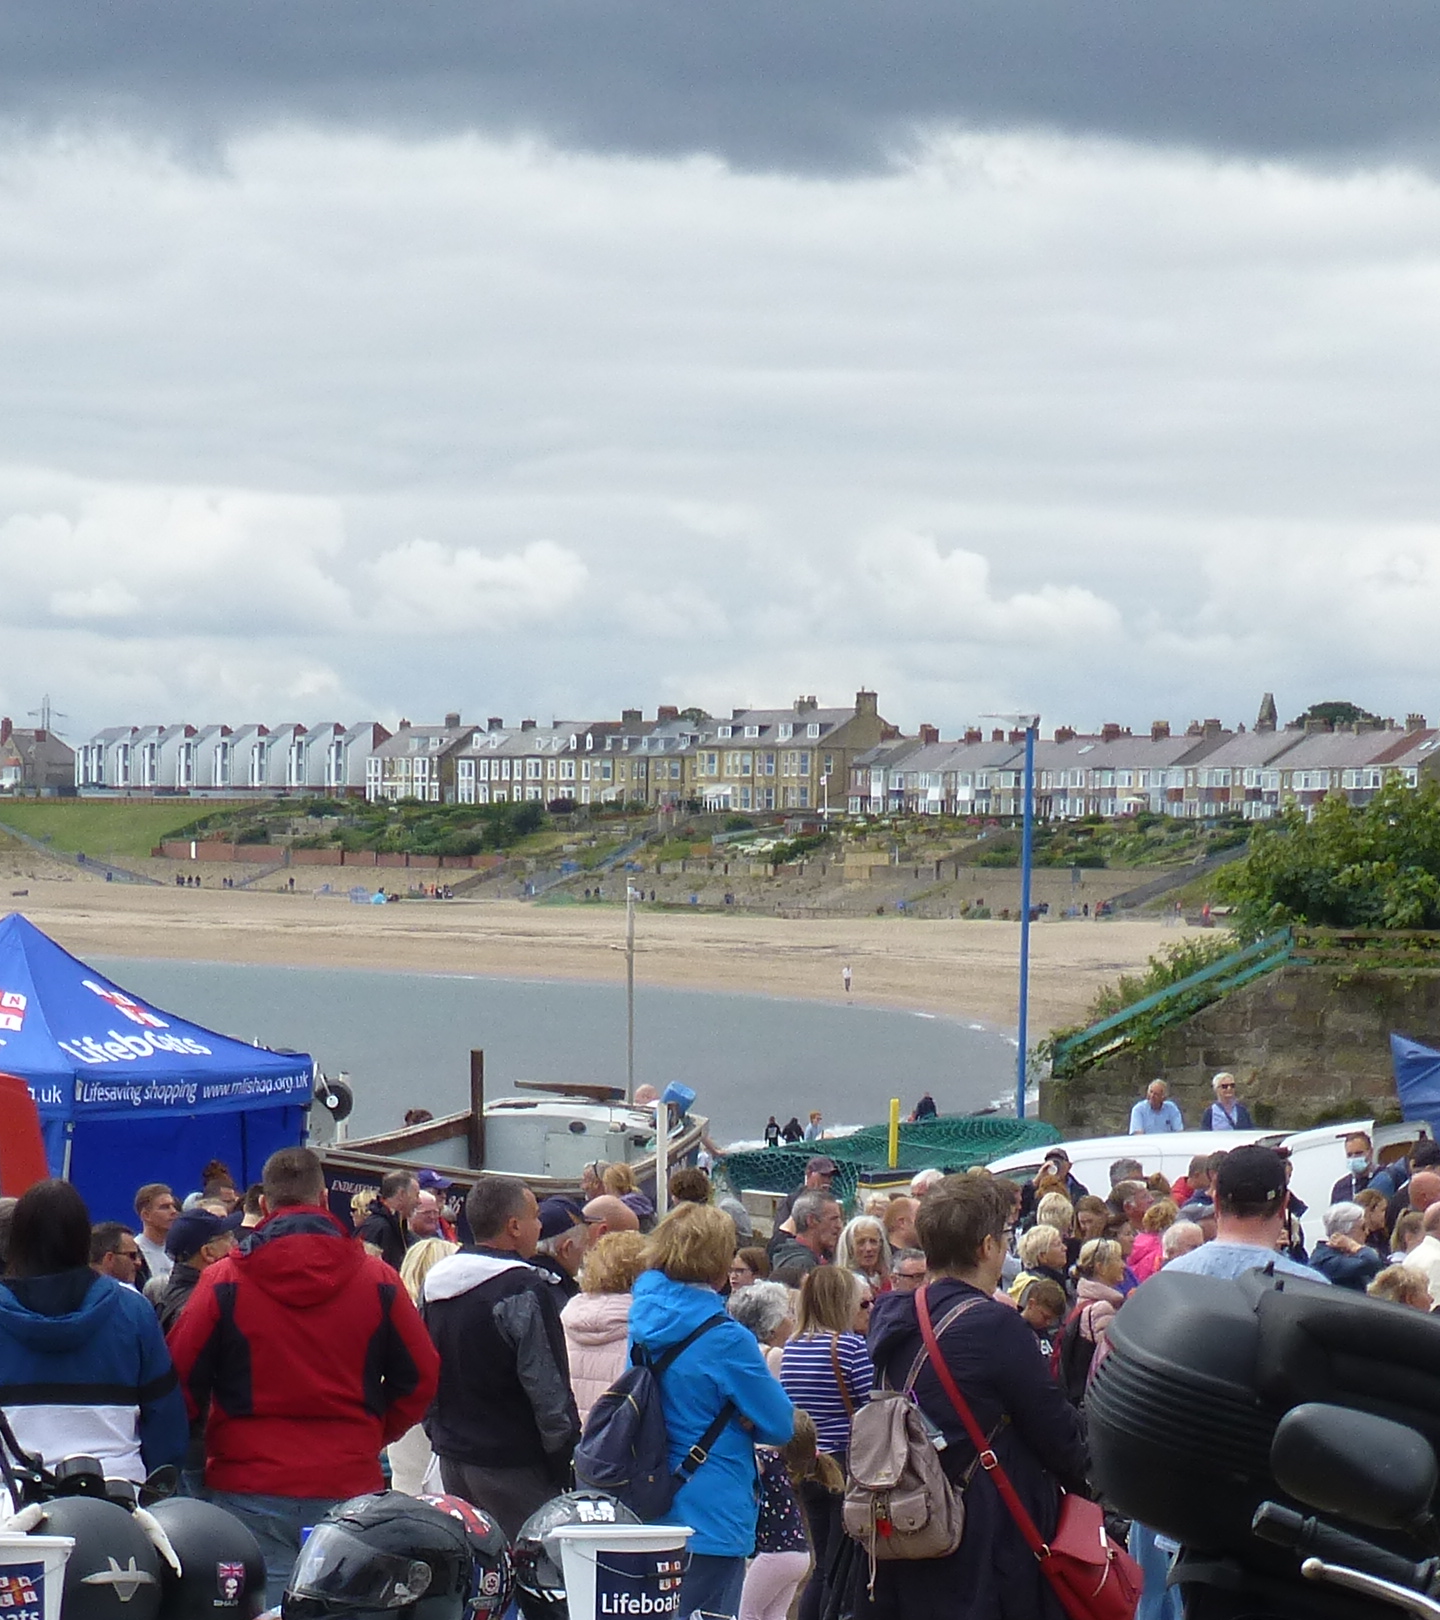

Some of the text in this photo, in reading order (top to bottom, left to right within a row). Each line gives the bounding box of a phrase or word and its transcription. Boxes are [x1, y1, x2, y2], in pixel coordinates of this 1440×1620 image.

[58, 1029, 212, 1064] Lifeboats
[83, 1080, 142, 1106] Lifesaving
[143, 1079, 198, 1105] shopping
